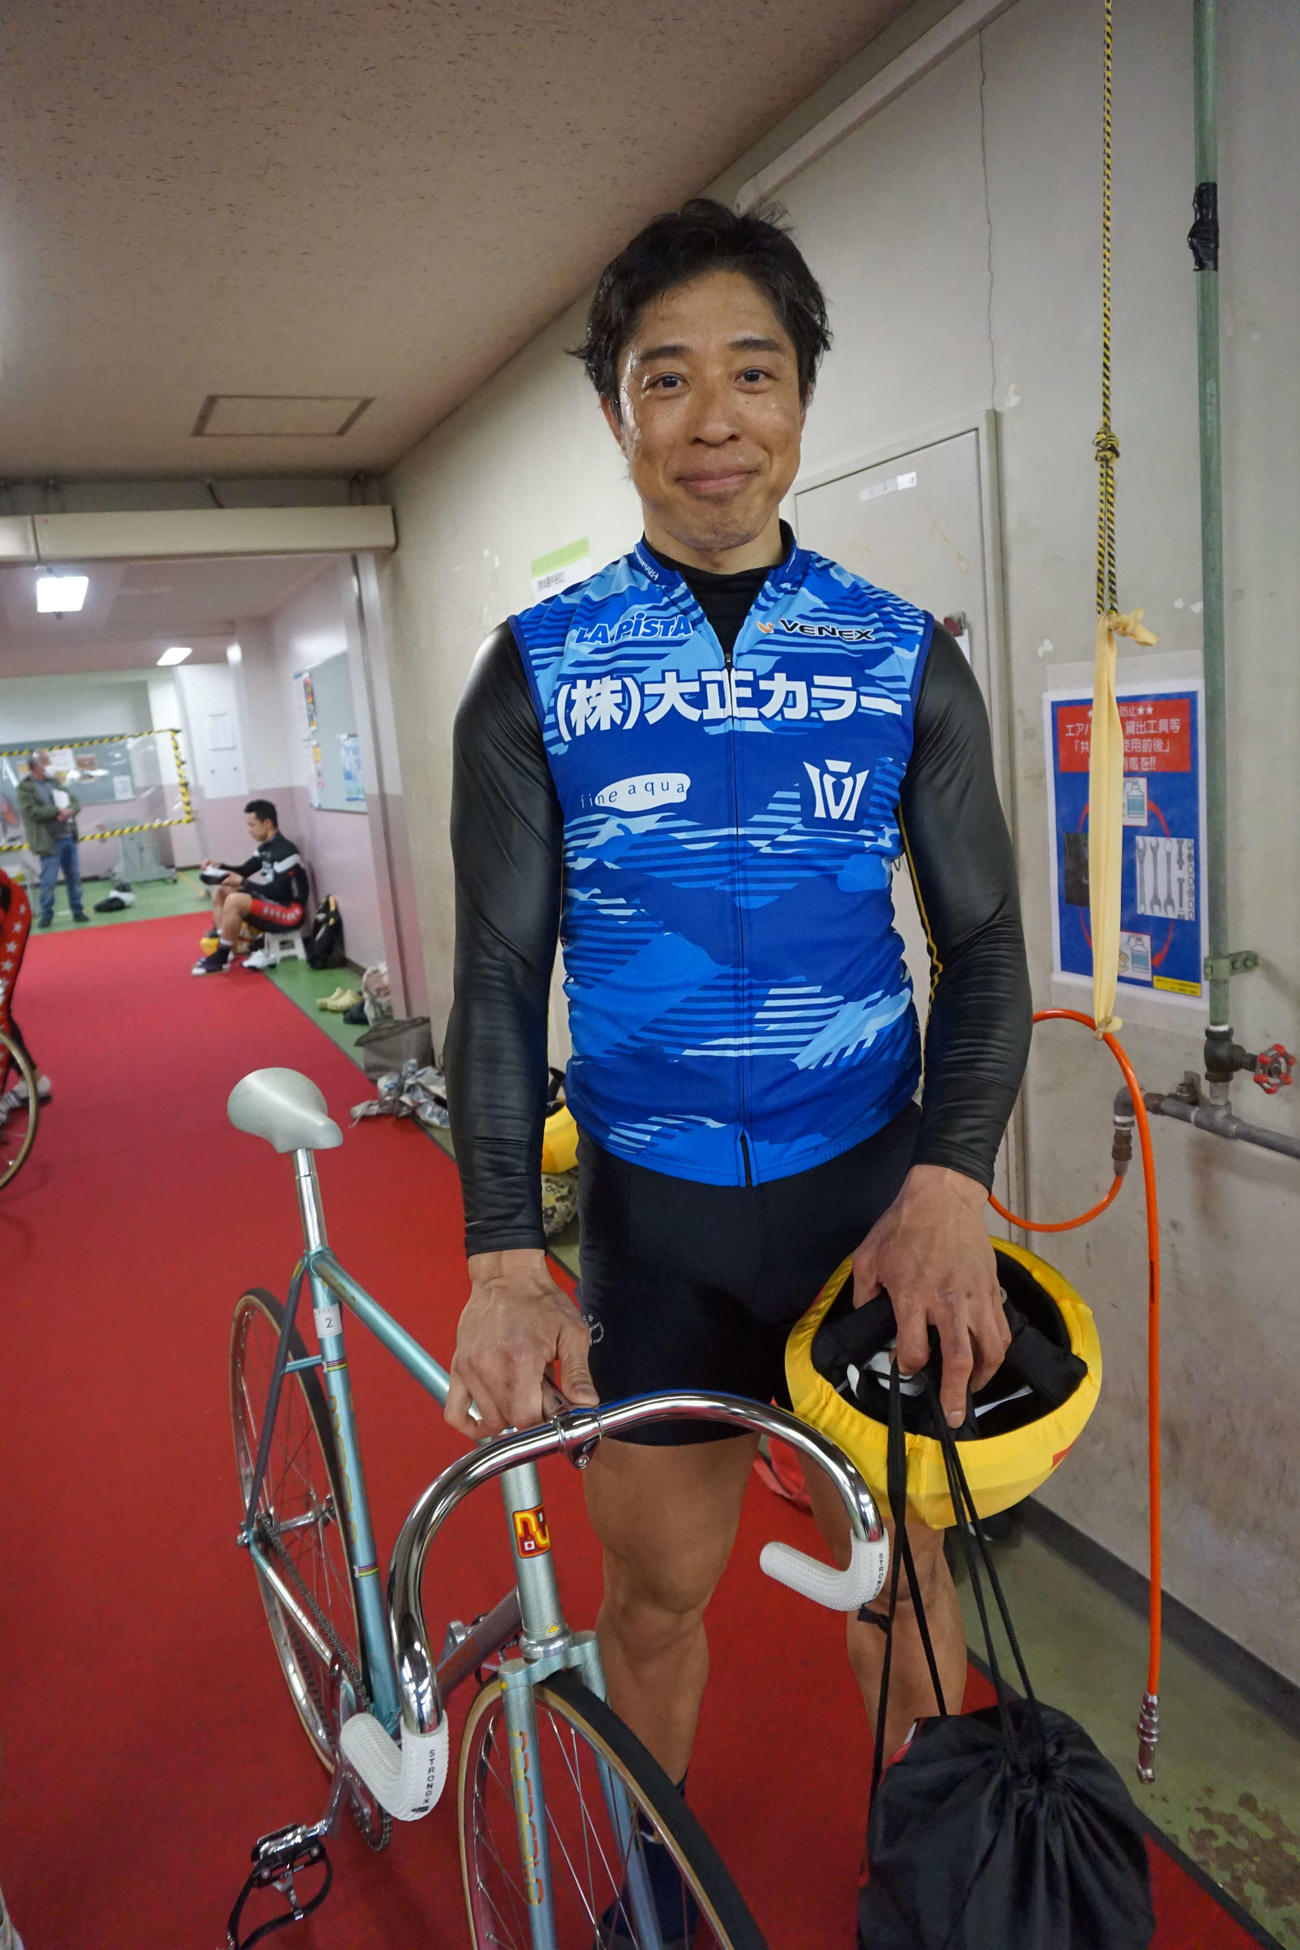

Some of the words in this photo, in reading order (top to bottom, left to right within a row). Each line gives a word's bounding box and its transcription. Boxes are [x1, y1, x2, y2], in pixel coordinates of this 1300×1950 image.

[574, 623, 610, 645] LA
[779, 618, 875, 641] VENEX
[556, 668, 903, 742] (株)大正カラー
[627, 781, 684, 796] aqua
[325, 1317, 333, 1329] 2
